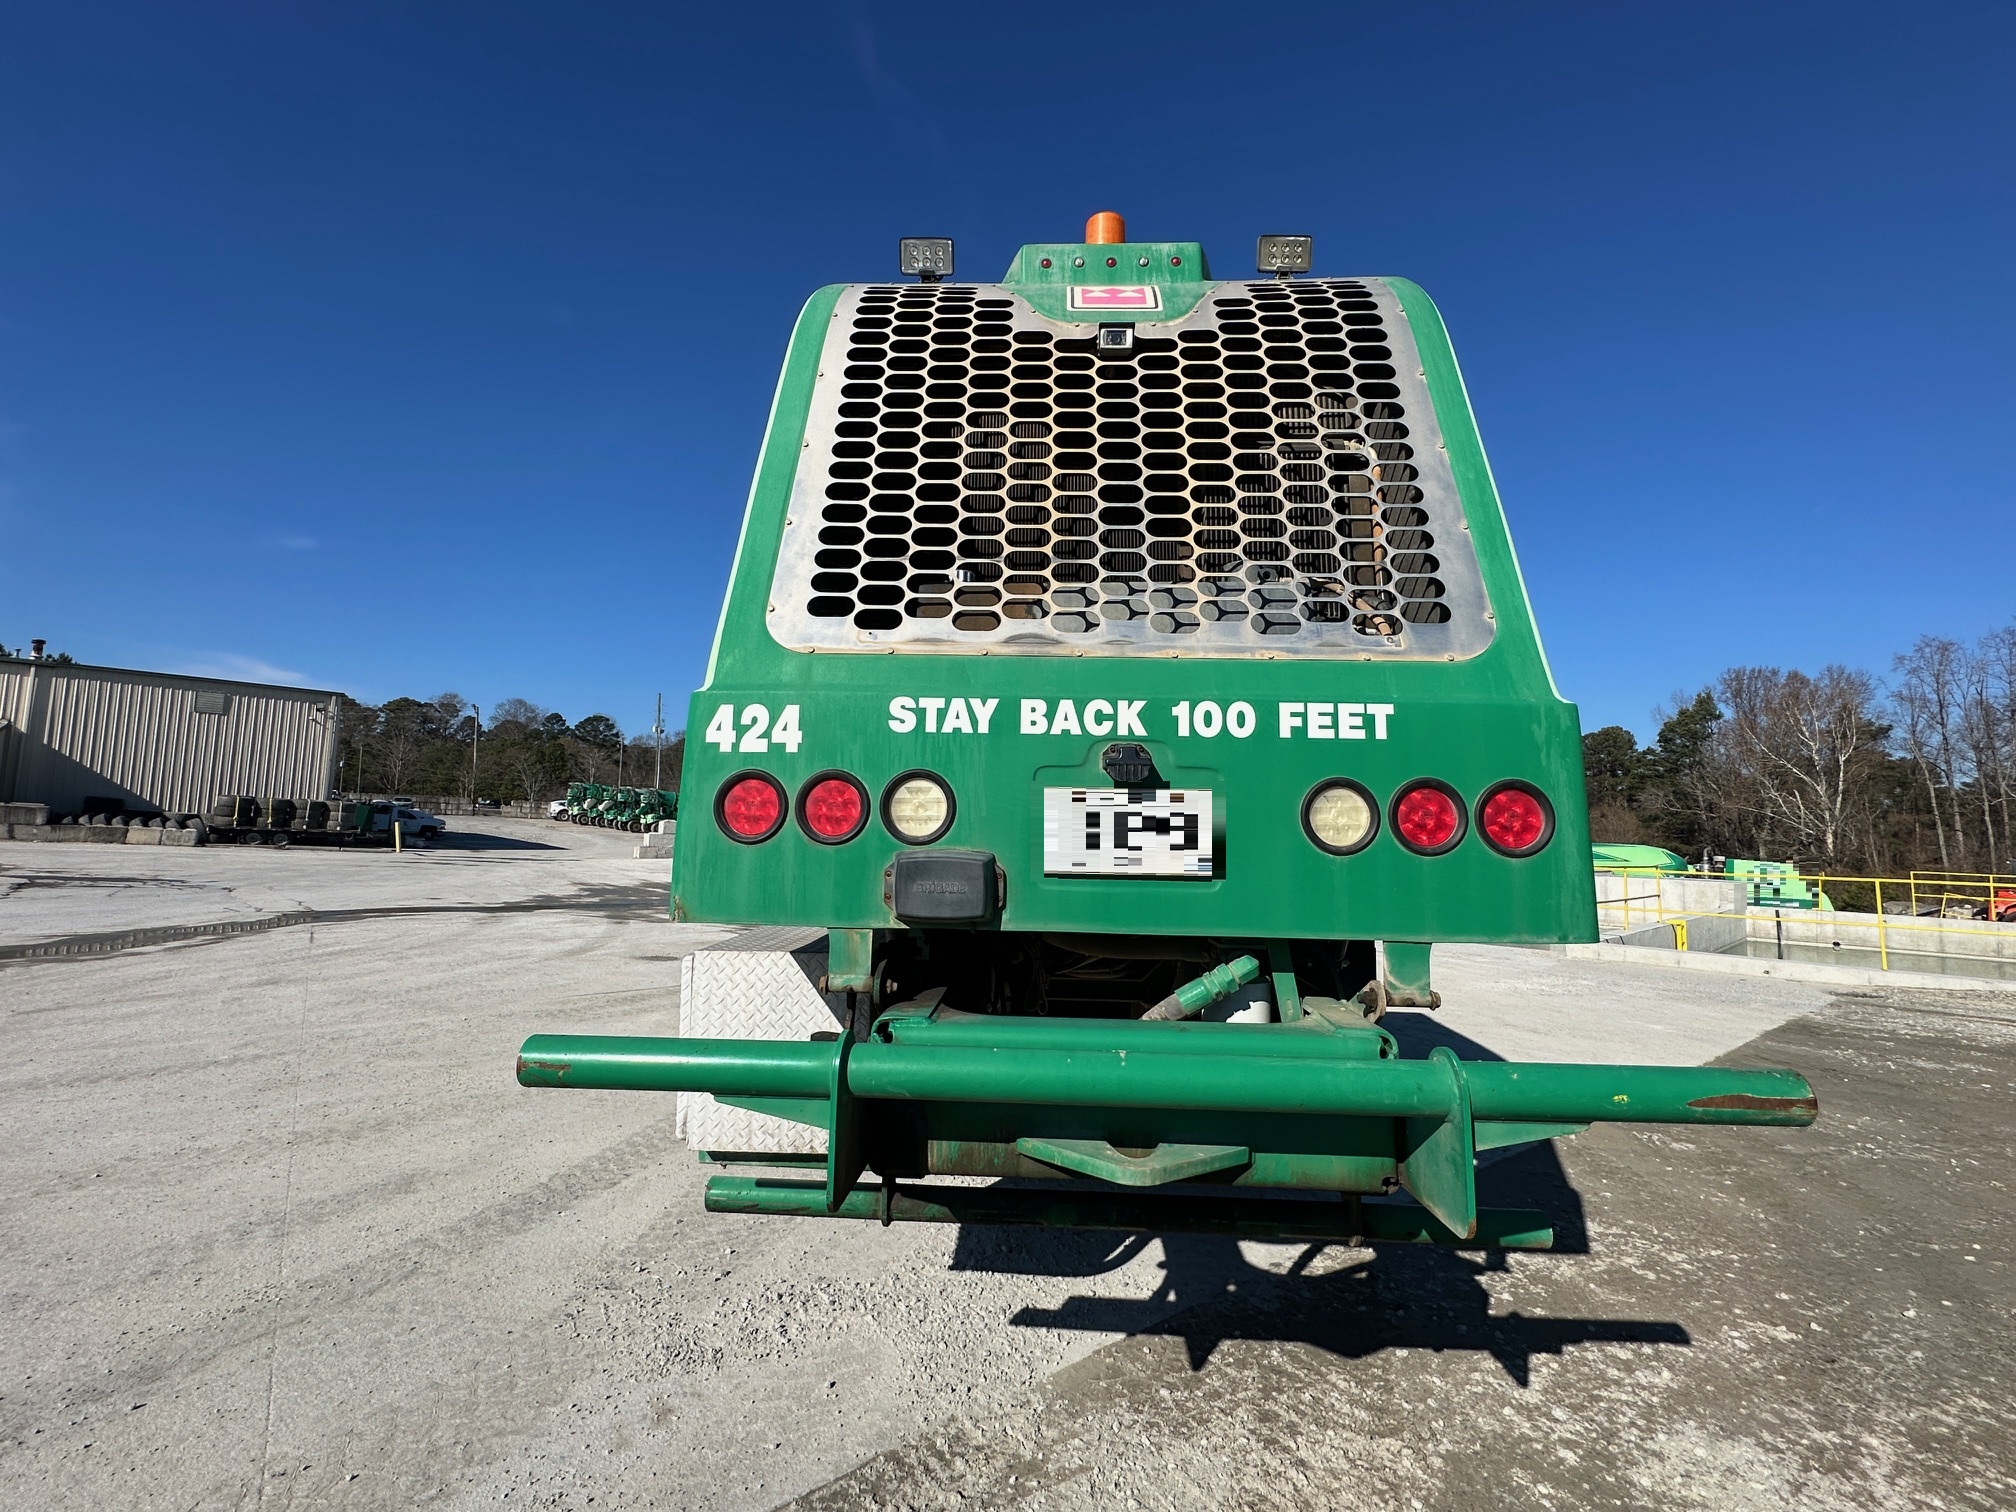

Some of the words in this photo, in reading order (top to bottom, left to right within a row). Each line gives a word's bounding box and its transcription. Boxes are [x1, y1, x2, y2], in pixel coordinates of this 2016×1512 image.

[704, 703, 803, 754] 424
[887, 695, 1000, 734] STAY
[1019, 698, 1148, 738] BACK
[1171, 700, 1257, 739] 100
[1278, 701, 1396, 740] FEET
[914, 881, 968, 895] BRIGADE
